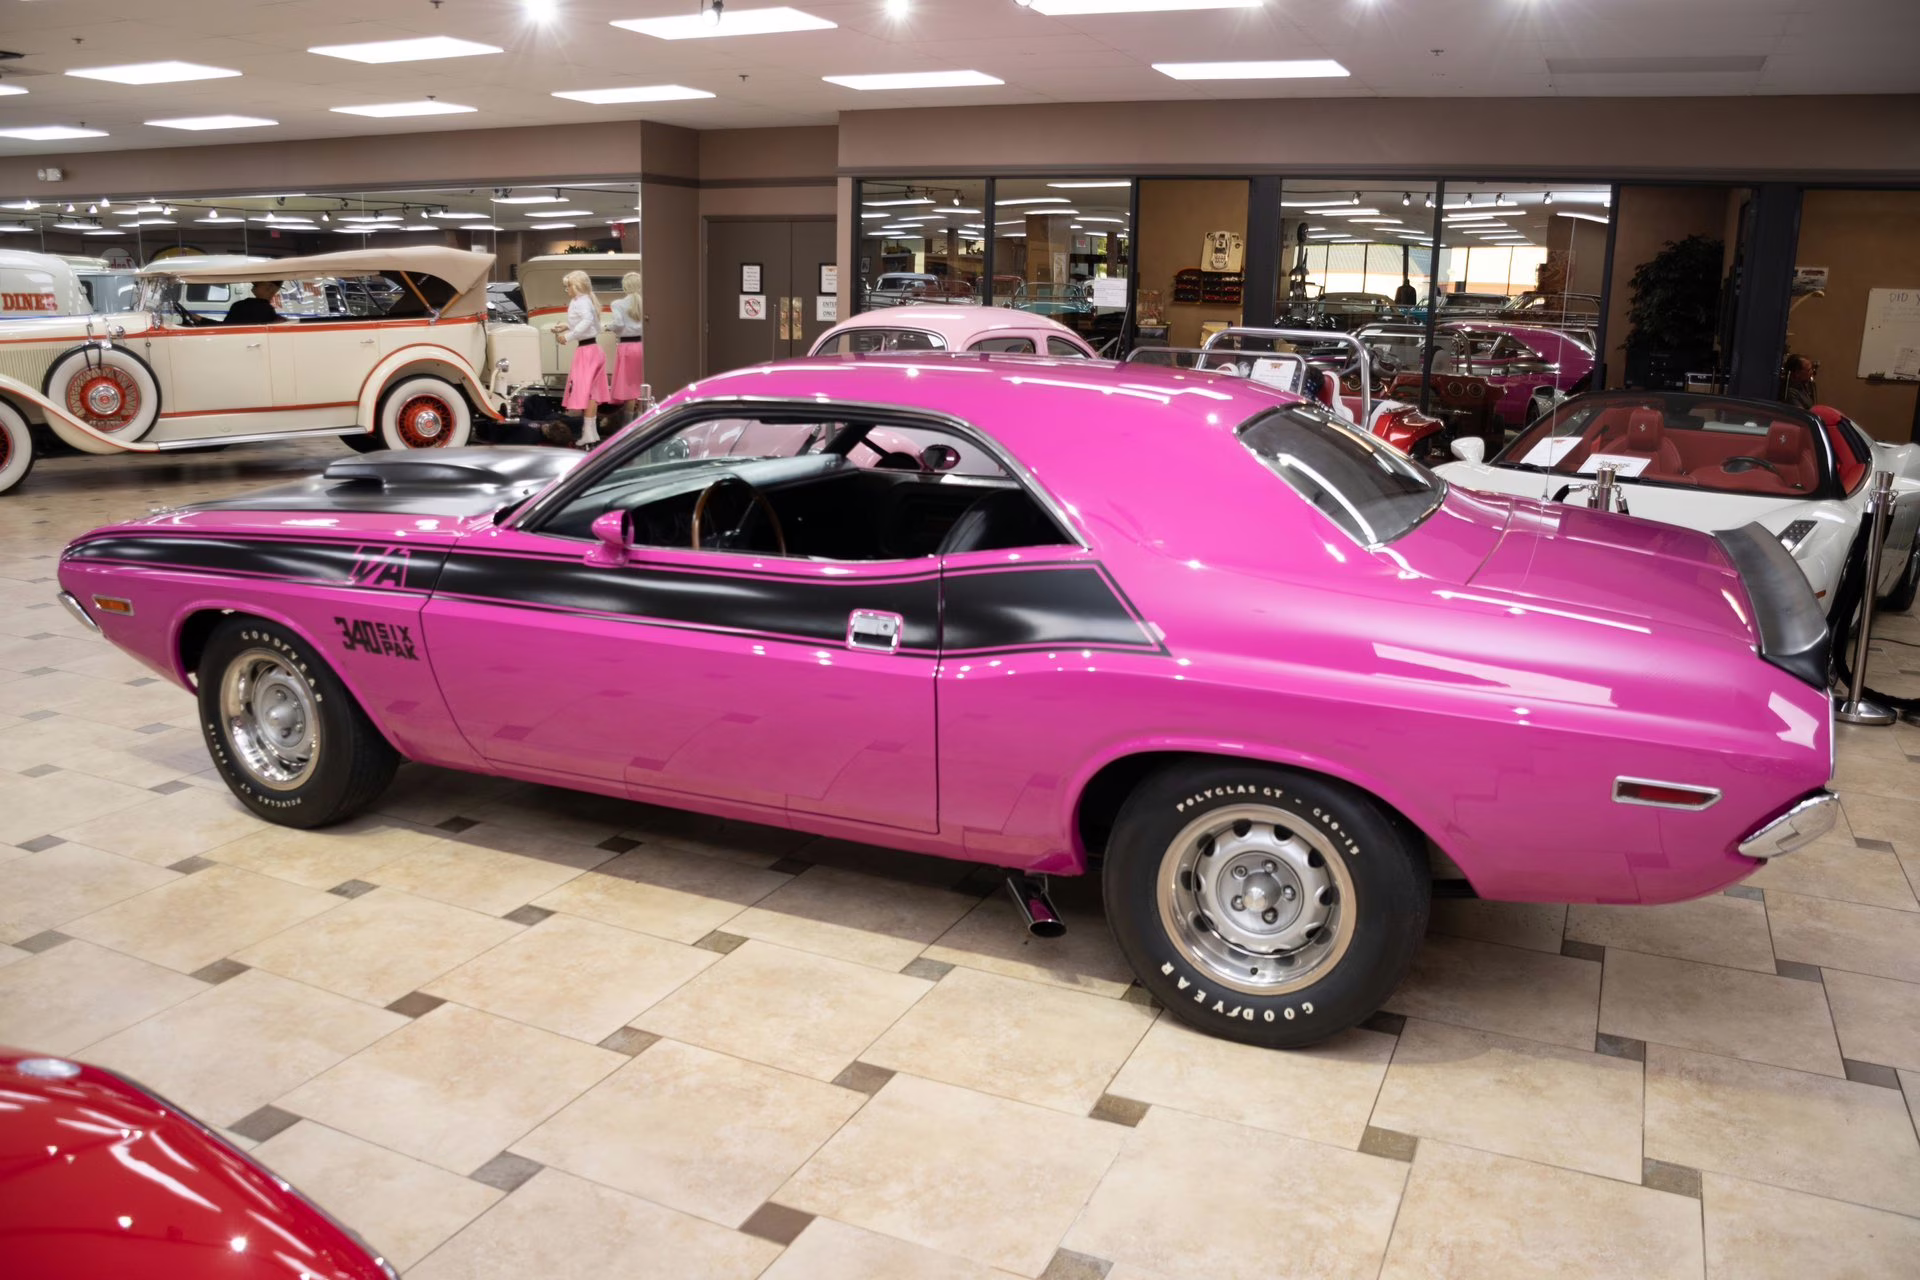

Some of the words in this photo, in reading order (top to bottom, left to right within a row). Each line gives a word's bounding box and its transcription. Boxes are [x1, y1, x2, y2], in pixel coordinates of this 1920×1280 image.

[334, 616, 382, 655] 340
[375, 622, 412, 643] SIX
[381, 640, 420, 661] PAK
[241, 630, 322, 702] GOODYEAR
[1176, 785, 1256, 812] POLYGLAS
[1263, 787, 1283, 798] GT
[1313, 808, 1360, 855] G60-15
[1161, 961, 1314, 1022] GOODYEAR
